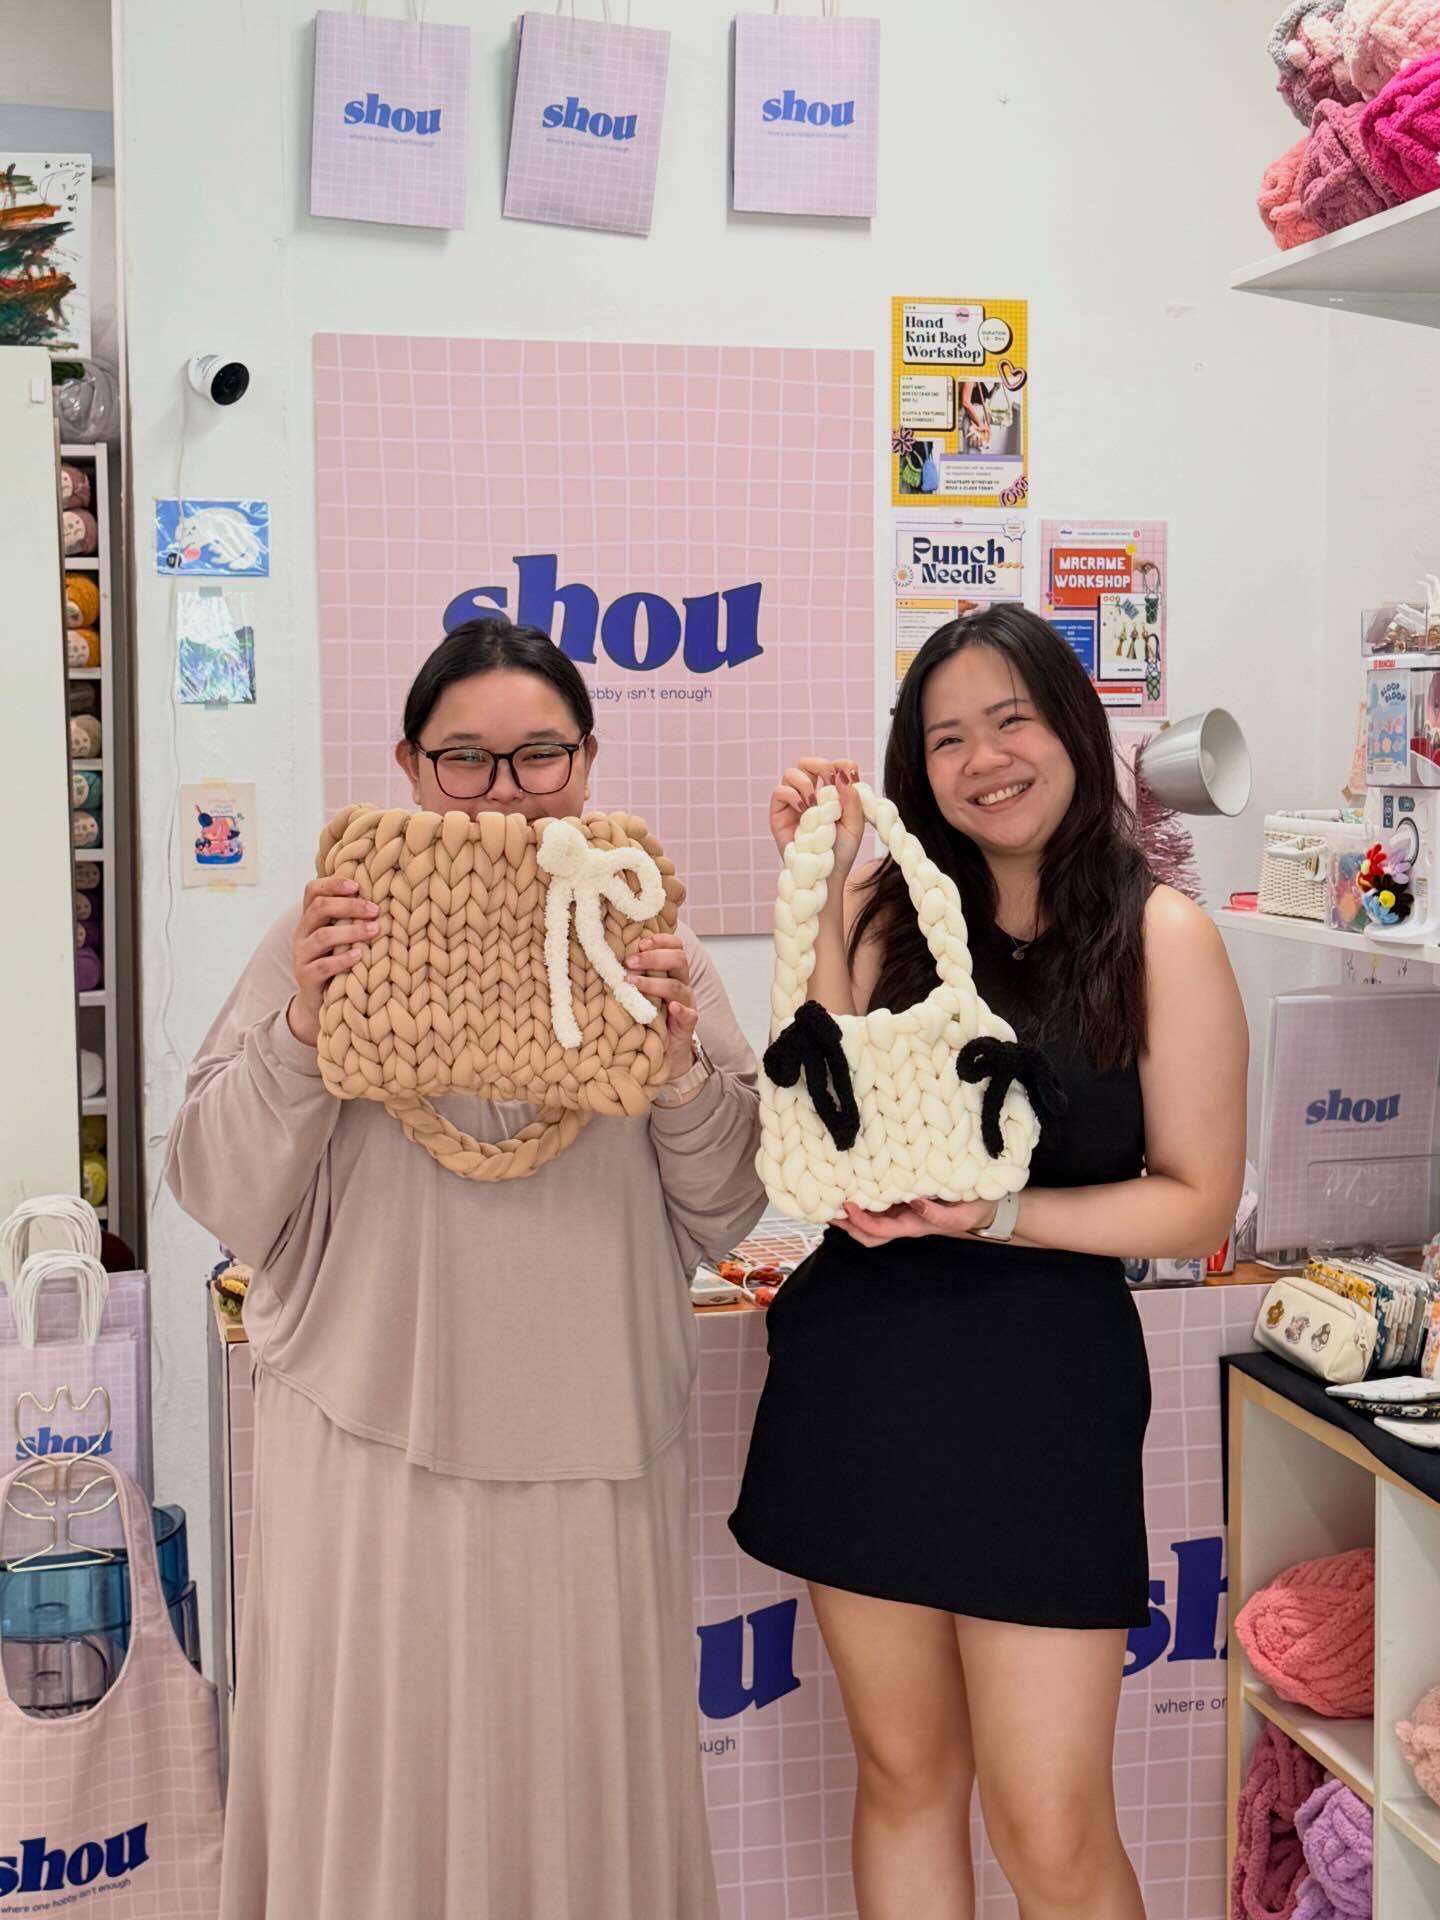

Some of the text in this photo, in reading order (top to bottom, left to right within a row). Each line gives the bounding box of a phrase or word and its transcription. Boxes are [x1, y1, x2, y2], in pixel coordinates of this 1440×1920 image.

[344, 93, 441, 135] shou
[542, 96, 638, 141] shou
[762, 90, 855, 127] shou
[905, 316, 943, 328] Hand
[905, 331, 967, 349] Knit Bag
[906, 346, 981, 363] Workshop
[913, 536, 1005, 566] Punch
[1059, 556, 1126, 570] MACRAME
[922, 563, 997, 584] Needle
[1055, 575, 1131, 588] WORKSHOP
[443, 554, 764, 674] shou
[589, 687, 712, 702] obby isn't enough
[1305, 1089, 1401, 1125] shou
[16, 1427, 112, 1461] shou
[1155, 1698, 1205, 1713] where
[32, 1902, 51, 1912] one
[98, 1878, 132, 1892] enough
